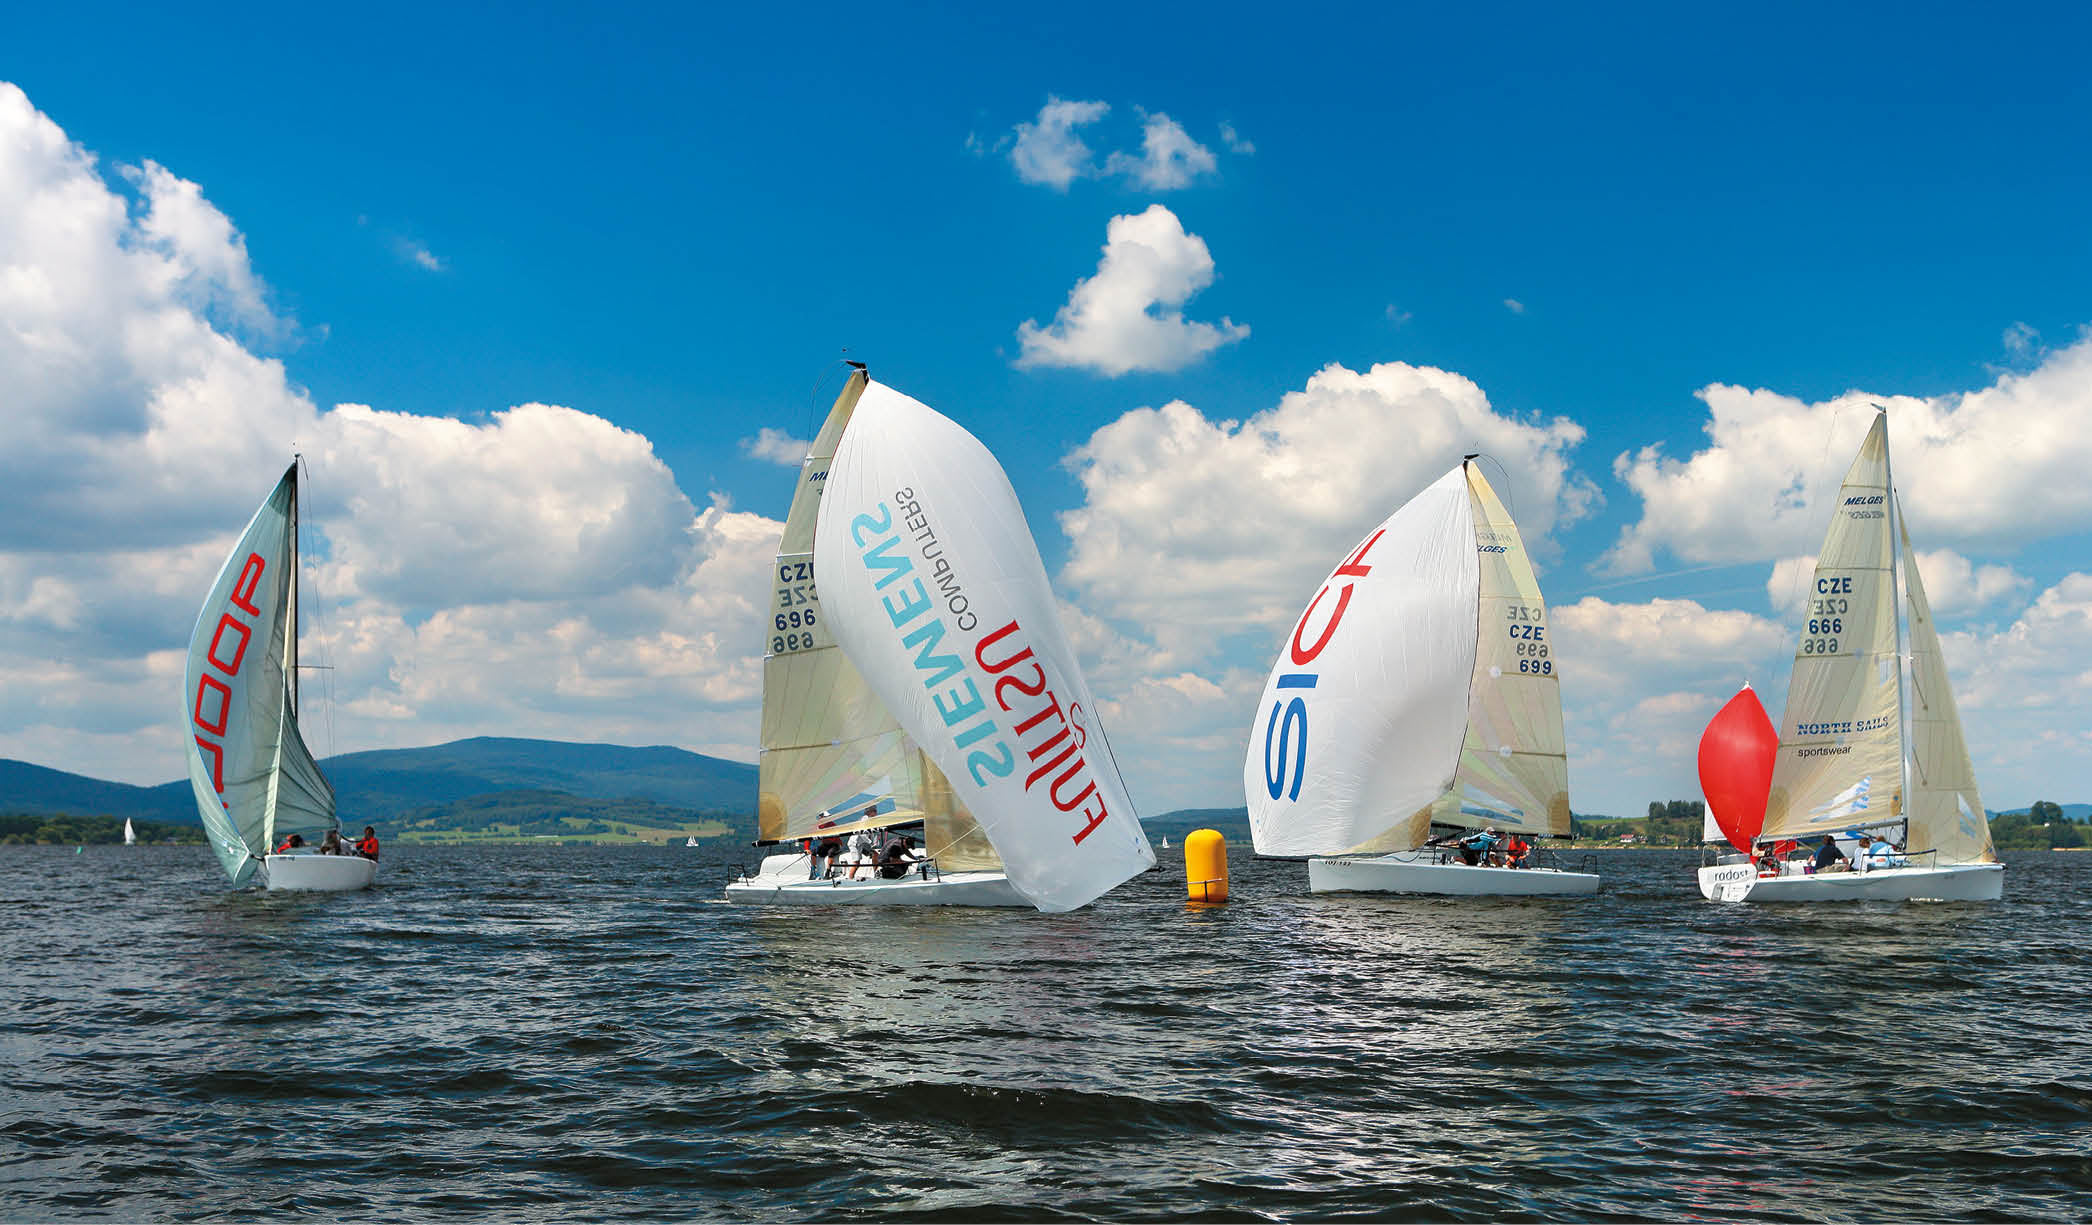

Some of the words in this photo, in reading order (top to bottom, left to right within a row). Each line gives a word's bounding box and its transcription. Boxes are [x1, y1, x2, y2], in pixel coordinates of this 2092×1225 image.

[1844, 495, 1884, 505] MELGES
[1477, 545, 1508, 553] LGES
[1817, 577, 1852, 594] CZE
[775, 608, 816, 631] 696
[1809, 618, 1842, 634] 666
[1509, 624, 1545, 641] CZE
[1519, 659, 1552, 675] 699
[1797, 721, 1852, 736] NORTH
[1856, 716, 1889, 732] SAILS
[1798, 746, 1852, 759] sportswear
